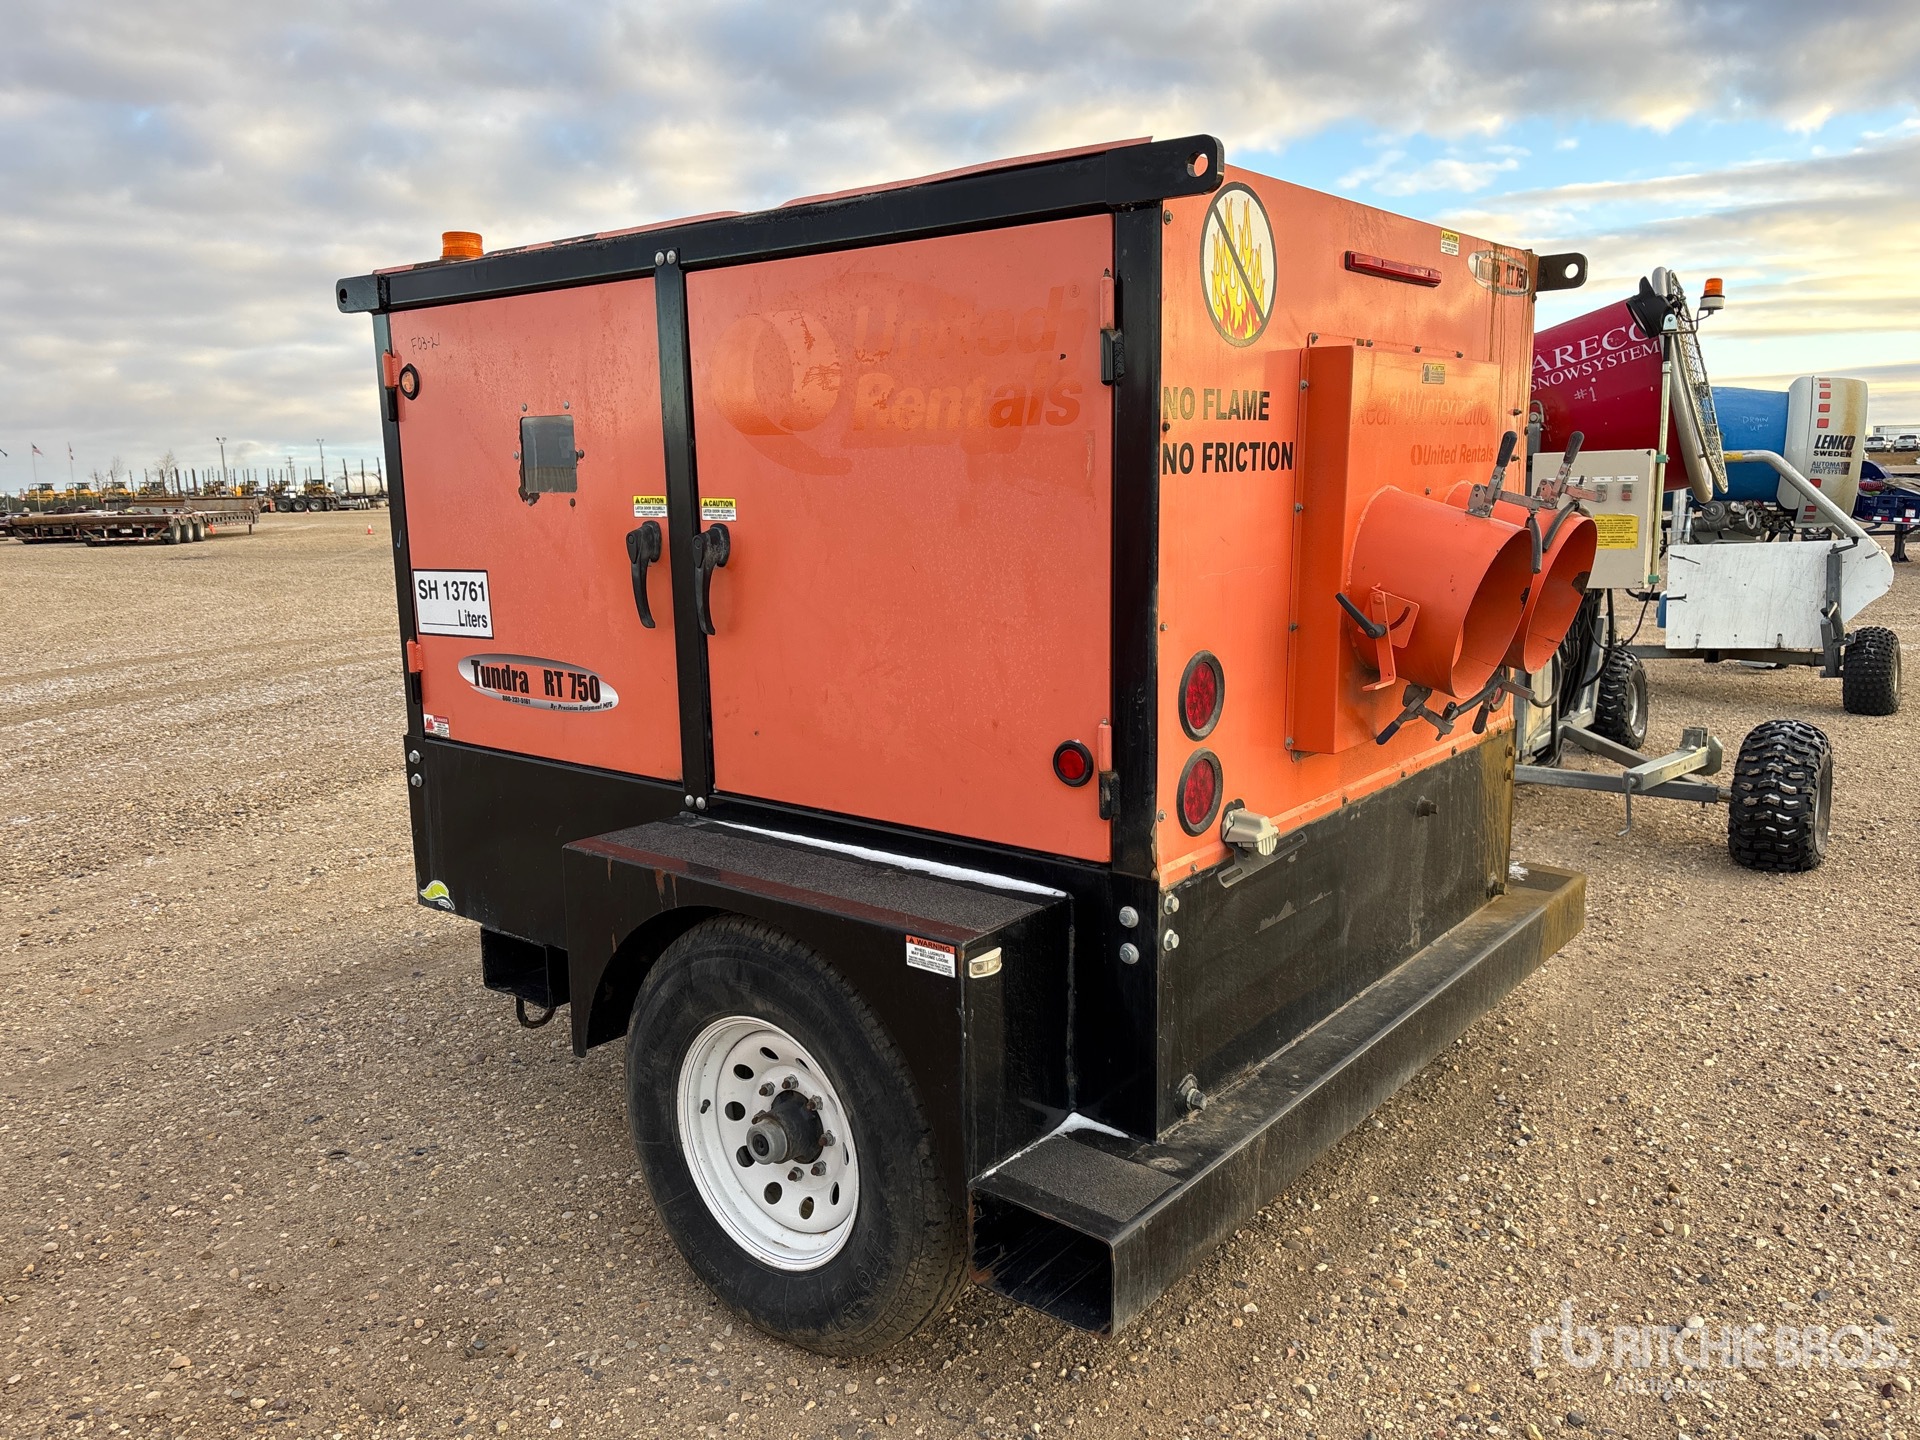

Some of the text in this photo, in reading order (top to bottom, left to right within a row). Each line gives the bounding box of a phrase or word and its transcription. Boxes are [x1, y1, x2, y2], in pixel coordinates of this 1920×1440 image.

[1516, 266, 1528, 289] 750
[852, 360, 1083, 432] Rentals
[1574, 386, 1597, 402] #1
[1162, 386, 1270, 421] NO FLAME
[1814, 434, 1856, 451] LENKO
[1162, 441, 1294, 475] NO FRICTION
[1422, 444, 1494, 466] United Rentals
[1813, 450, 1853, 458] SWEDEN
[1810, 467, 1826, 475] PIVOT
[1811, 461, 1851, 469] AUTOMAT
[417, 579, 486, 602] SH 13761
[457, 609, 488, 629] Liters
[471, 660, 601, 704] Tundra RT 750
[558, 703, 578, 711] Precision
[579, 703, 602, 712] Equipment
[914, 946, 928, 955] WHEEL
[916, 938, 951, 952] WARNING
